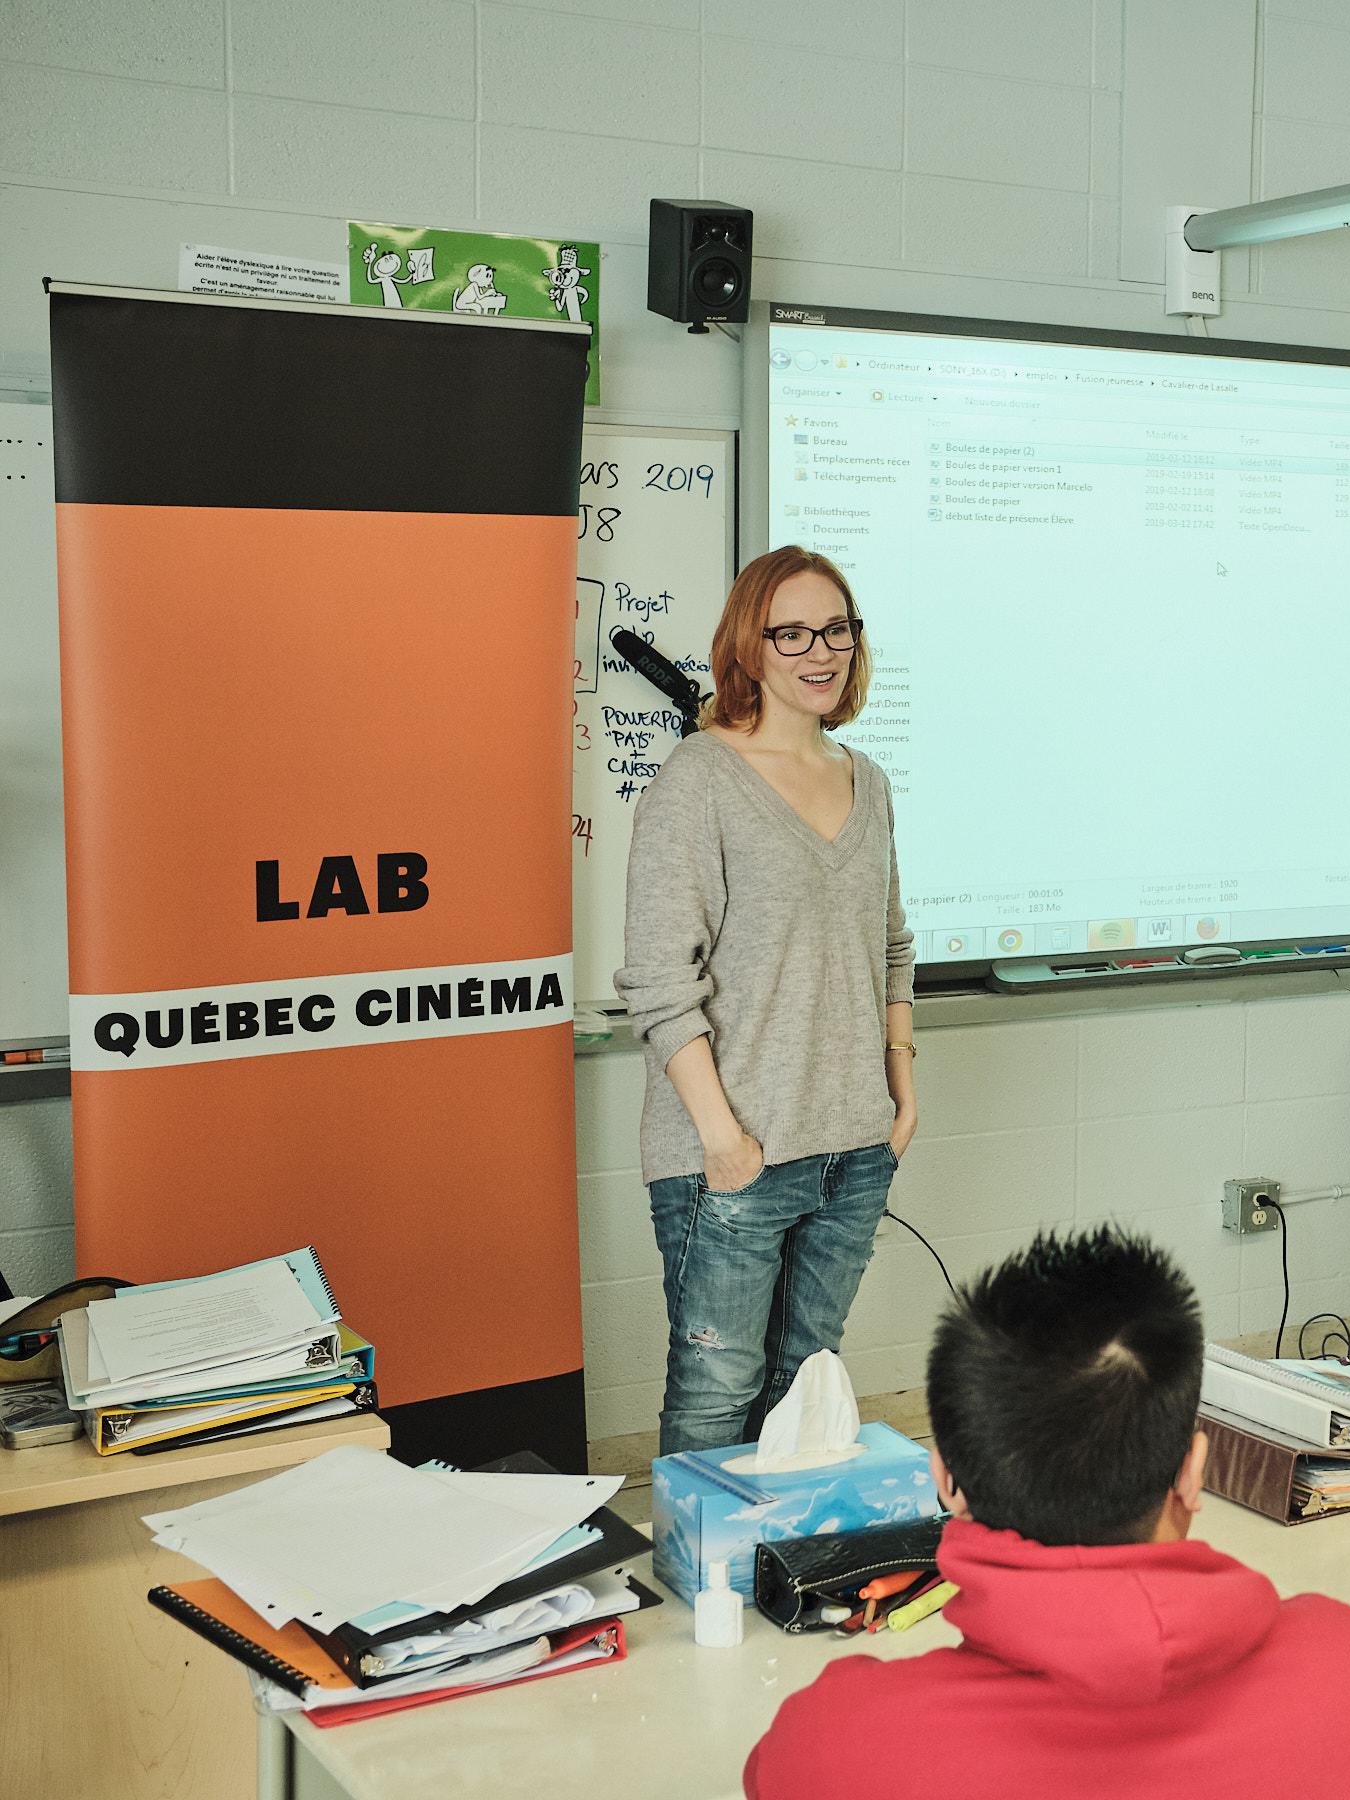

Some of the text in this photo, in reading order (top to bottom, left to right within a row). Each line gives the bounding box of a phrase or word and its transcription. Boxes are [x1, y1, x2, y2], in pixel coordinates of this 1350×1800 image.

[197, 253, 215, 261] Aider
[239, 258, 274, 270] dyslexique
[281, 264, 292, 272] lire
[294, 266, 310, 274] votre
[312, 268, 339, 278] question
[194, 261, 214, 269] écrite
[216, 264, 232, 272] n'est
[250, 267, 279, 279] privilège
[298, 275, 331, 286] traitement
[192, 286, 217, 294] permet
[200, 277, 218, 286] C'est
[229, 282, 274, 293] aménagement
[276, 287, 315, 300] raisonnable
[316, 293, 326, 301] qui
[775, 308, 804, 320] SMART
[868, 360, 920, 372] Ordinateur
[1075, 374, 1144, 387] Fusion jeunesse
[782, 386, 830, 398] Organiser
[888, 392, 924, 403] Lecture
[803, 417, 839, 428] Favoris
[813, 435, 848, 446] Bureau
[946, 443, 1035, 457] Boules de papier (2)
[813, 453, 885, 466] Emplacements
[946, 460, 1062, 474] Boules de papier version 1
[579, 461, 714, 499] ars 2019
[813, 471, 896, 483] Téléchargements
[946, 478, 1093, 492] Boules de papier version Marcelo
[946, 494, 1021, 508] Boules de papier
[975, 512, 994, 522] liste
[995, 513, 1007, 522] de
[813, 524, 870, 535] Documents
[813, 542, 849, 553] Images
[614, 582, 675, 622] Projet
[576, 724, 592, 750] 3
[255, 851, 430, 922] LAB
[1219, 879, 1238, 889] 1920
[906, 897, 919, 906] de
[921, 893, 957, 907] papier
[958, 893, 972, 905] (2)
[1219, 892, 1238, 902] 1080
[1028, 903, 1044, 913] 183
[93, 972, 565, 1058] QUÉBEC CINÉMA
